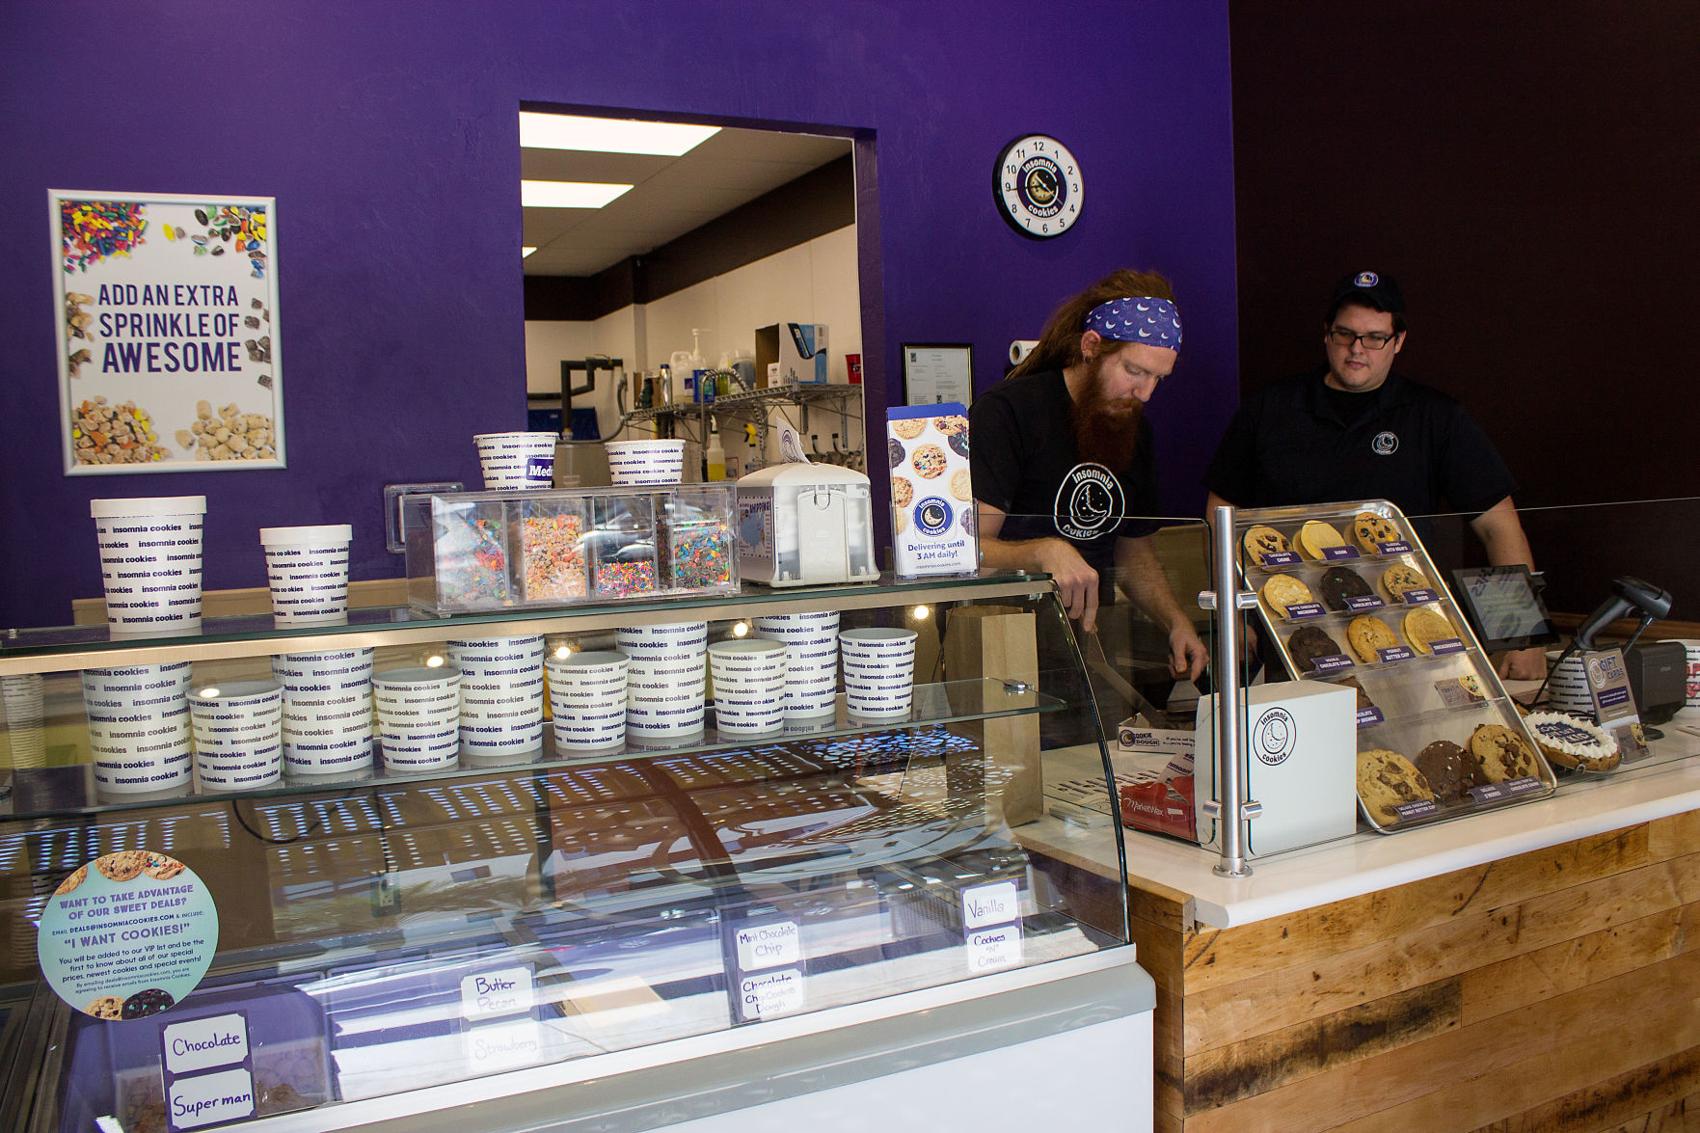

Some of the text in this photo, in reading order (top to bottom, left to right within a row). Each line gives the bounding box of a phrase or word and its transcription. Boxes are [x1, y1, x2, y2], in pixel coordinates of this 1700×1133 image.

[1033, 142, 1044, 151] 12
[1017, 149, 1025, 158] 11
[1055, 150, 1059, 159] 1
[1007, 165, 1016, 174] 10
[1068, 166, 1073, 175] 2
[1006, 182, 1011, 192] 9
[1073, 184, 1079, 192] 3
[1012, 204, 1018, 213] 8
[1028, 206, 1058, 217] cookies
[1070, 204, 1075, 212] 4
[1026, 219, 1031, 228] 7
[1043, 224, 1048, 233] 6
[1060, 219, 1066, 227] 5
[98, 285, 239, 306] ADD AN EXTRA
[100, 314, 239, 337] SPRINKLE OF
[103, 342, 242, 373] AWESOME
[113, 524, 181, 534] insomnia cookies
[908, 540, 965, 552] Delivering until
[126, 555, 157, 563] cookies
[938, 550, 959, 559] daily!
[272, 560, 324, 569] insomnia cookies
[118, 568, 182, 579] insomnia cookies
[122, 613, 183, 624] insomnia cookies
[759, 625, 814, 634] insomnia cookies
[858, 639, 907, 648] insomnia cookies
[287, 651, 355, 663] insomnia cookies
[461, 653, 524, 663] insomnia cookies
[631, 652, 690, 662] insomnia cookies
[560, 666, 614, 675] insomnia cookies
[104, 679, 176, 692] insomnia cookies
[384, 685, 412, 693] insomnia
[208, 722, 266, 733] insomnia cookies
[469, 737, 525, 747] insomnia cookies
[1262, 751, 1287, 764] cookies
[115, 771, 178, 785] insomnia cookies
[60, 885, 193, 909] WANT TO TAKE ADVANTAGE
[69, 898, 187, 920] OF OUR SWEET DEALS?
[968, 899, 1004, 918] Vanilla
[759, 926, 796, 941] Chocolate
[80, 933, 116, 946] WANT
[974, 934, 1005, 946] Cookies
[756, 944, 782, 956] Chip
[59, 957, 72, 965] You
[74, 955, 84, 963] will
[98, 951, 120, 959] added
[70, 964, 84, 972] first
[96, 960, 113, 968] know
[116, 957, 136, 965] about
[171, 949, 194, 959] special
[86, 969, 110, 978] newest
[113, 966, 137, 974] cookies
[154, 960, 177, 968] special
[476, 977, 516, 994] Butter
[477, 995, 517, 1010] Pecan
[172, 1033, 241, 1056] Chocolate
[475, 1035, 537, 1061] Strawberry
